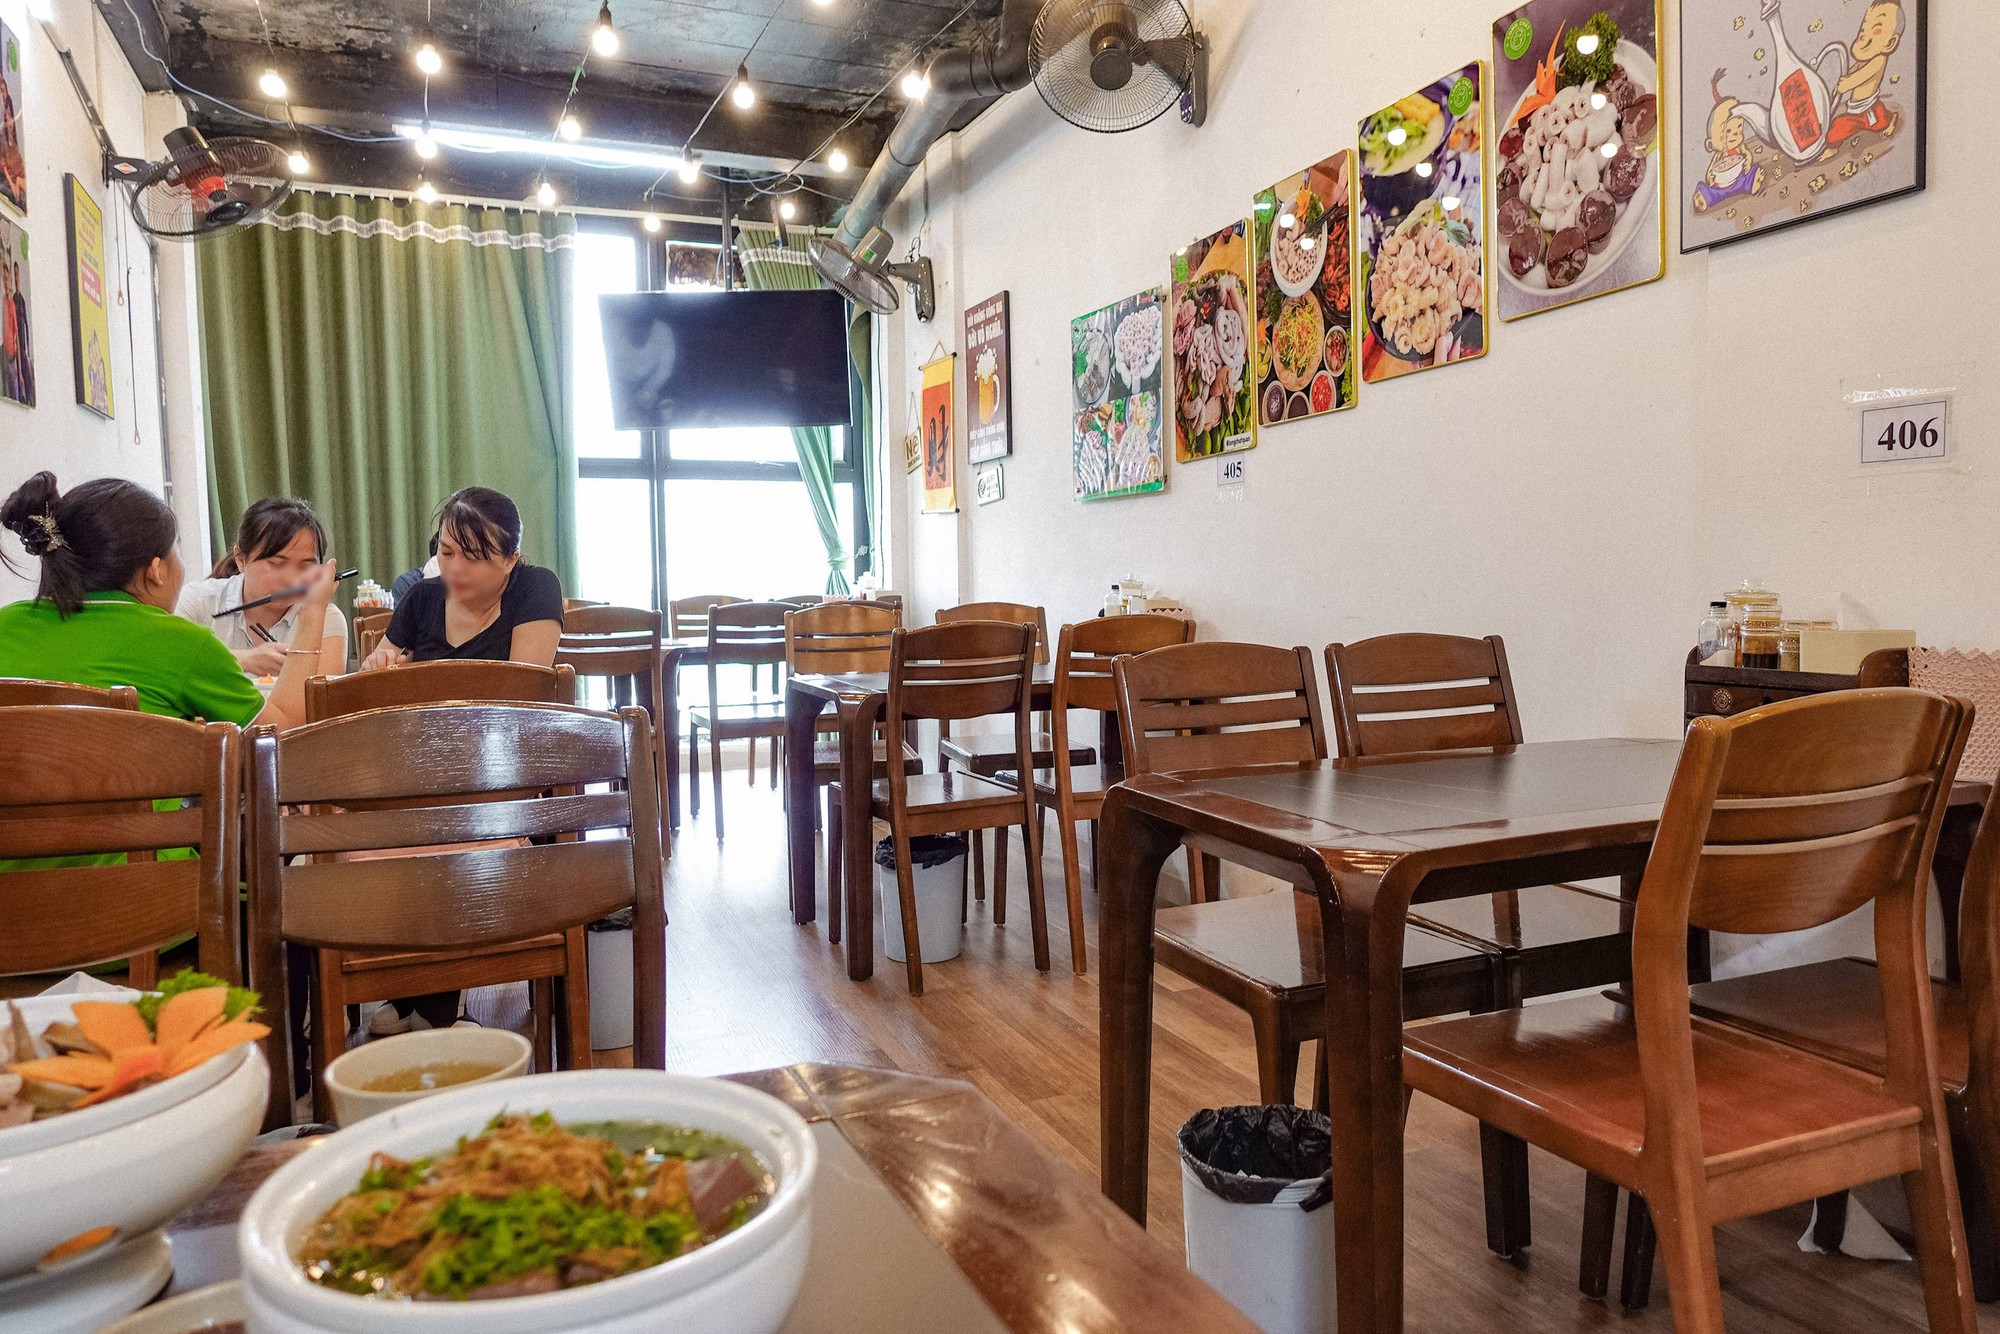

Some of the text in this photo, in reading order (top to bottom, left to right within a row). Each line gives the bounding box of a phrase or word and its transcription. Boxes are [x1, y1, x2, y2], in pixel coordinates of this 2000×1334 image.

[1877, 416, 1939, 451] 406
[906, 435, 919, 461] NO
[1223, 461, 1242, 479] 405
